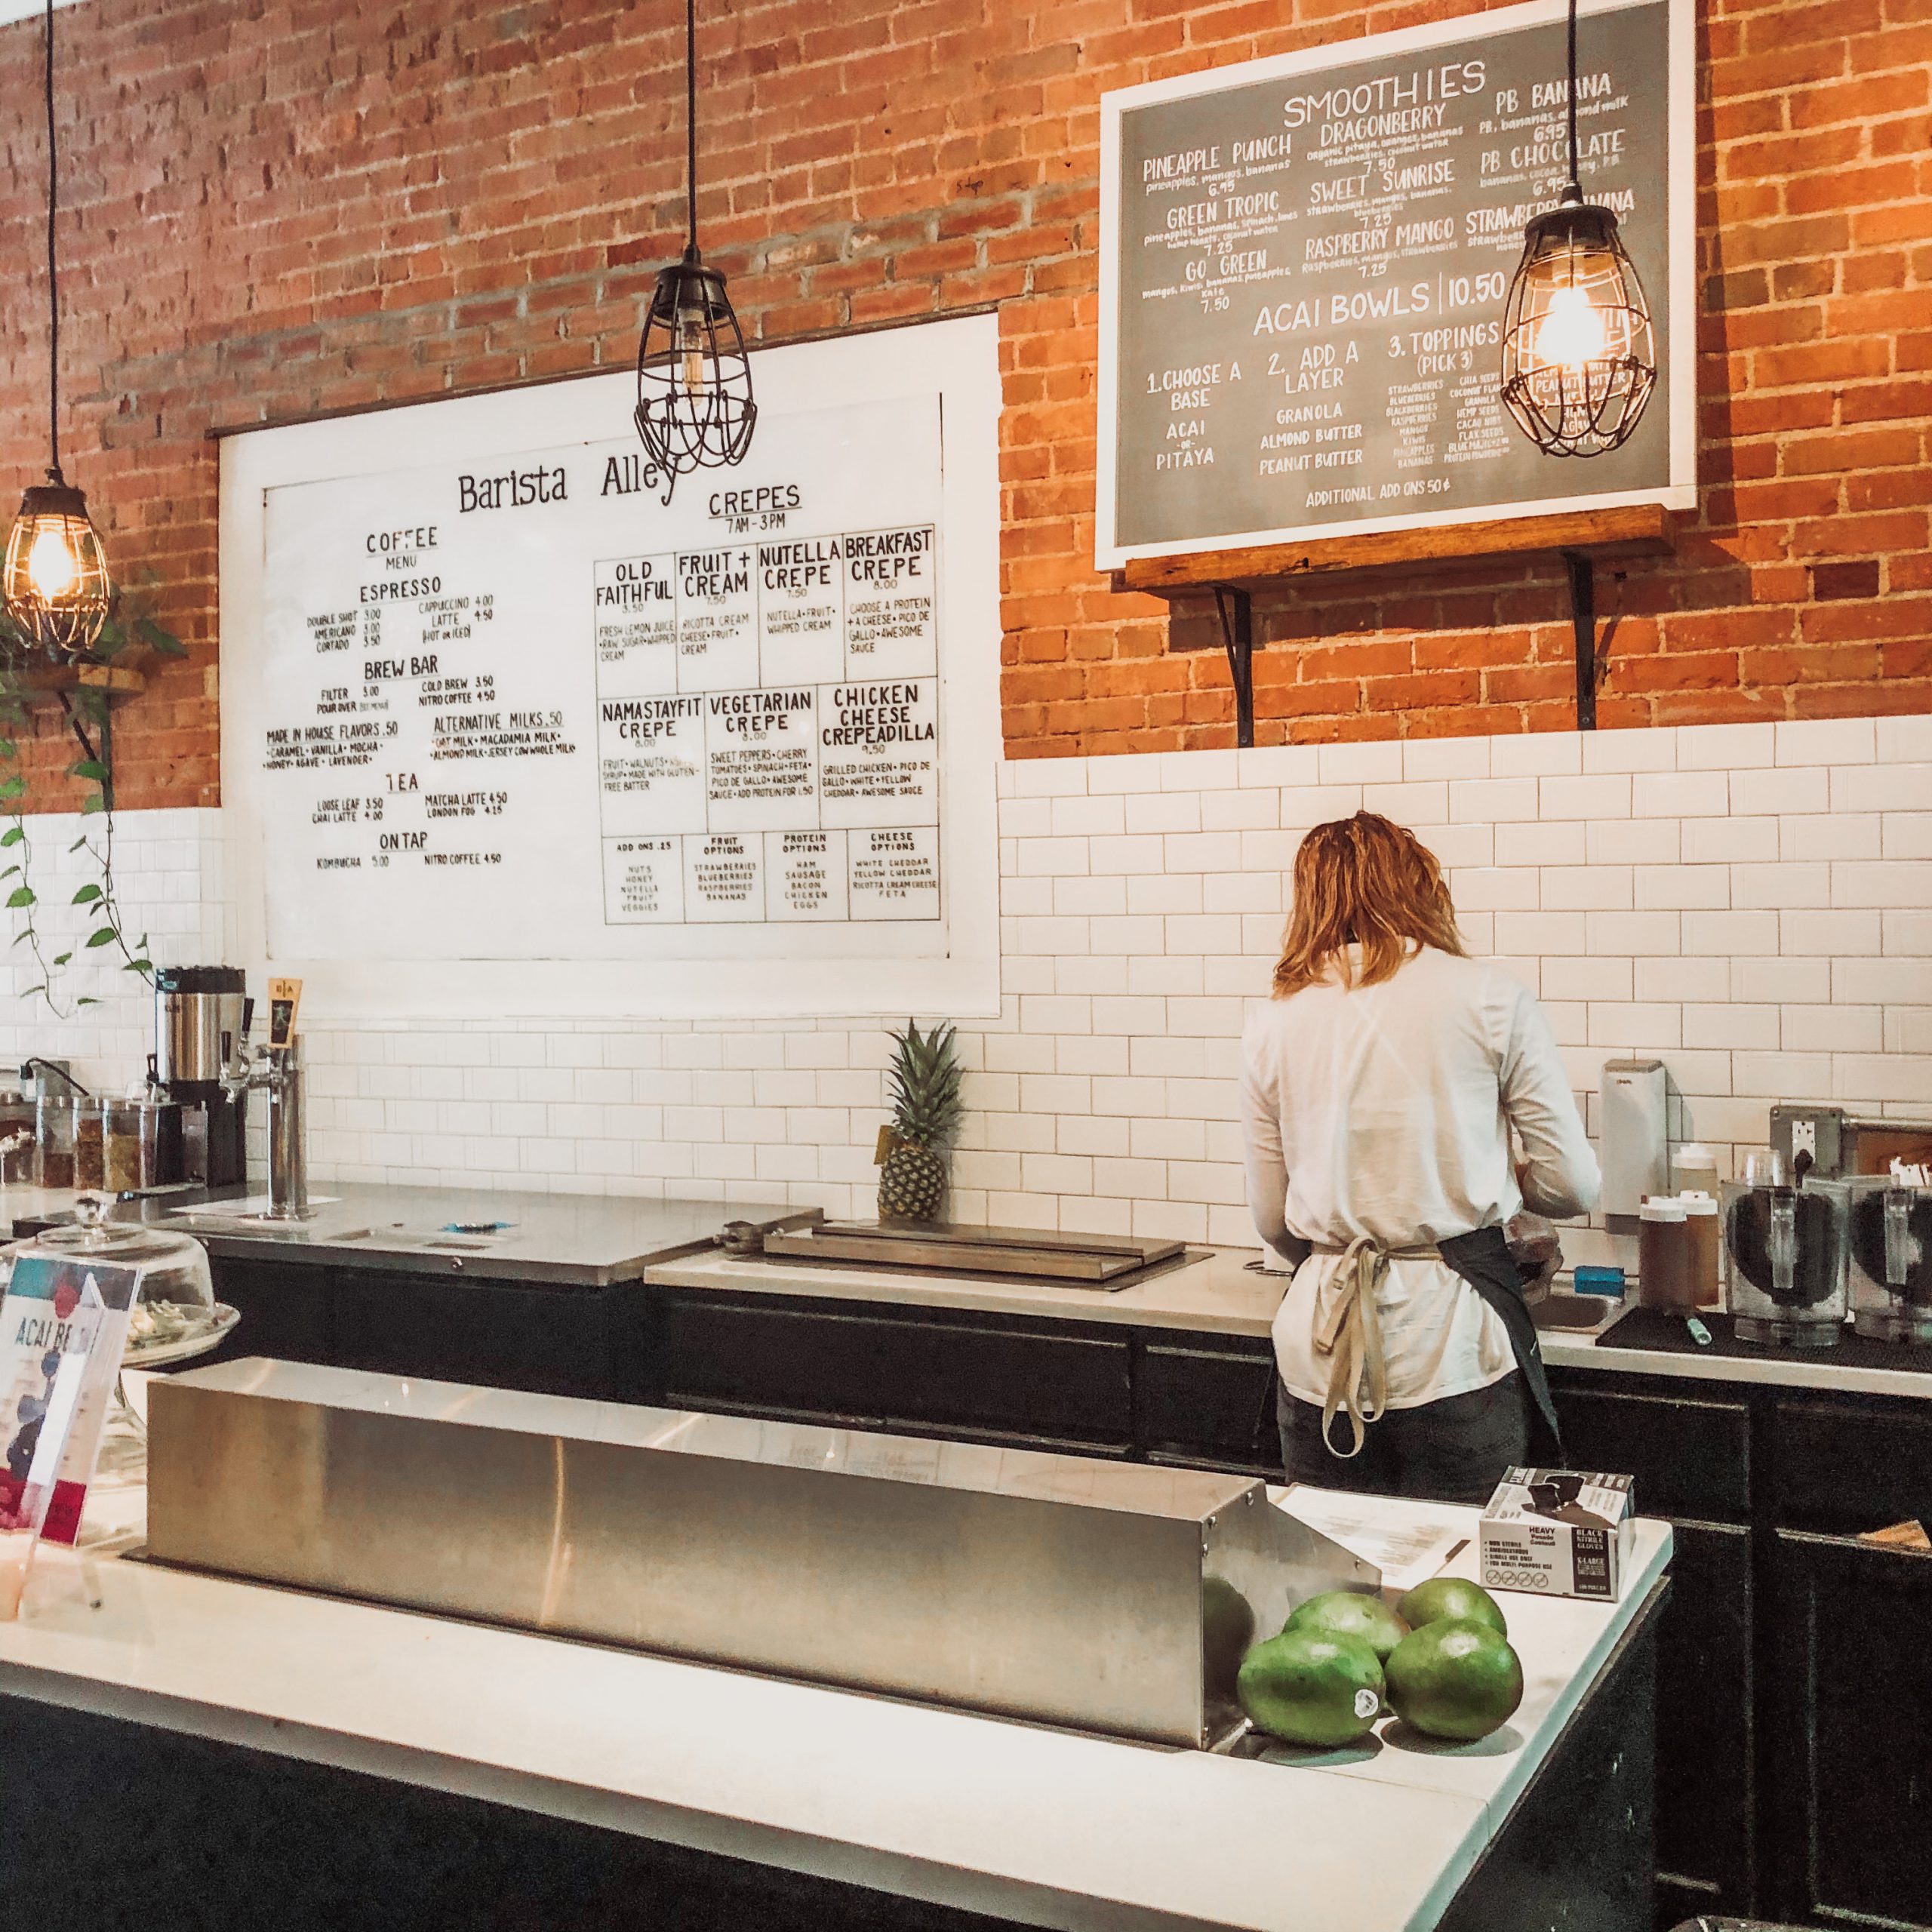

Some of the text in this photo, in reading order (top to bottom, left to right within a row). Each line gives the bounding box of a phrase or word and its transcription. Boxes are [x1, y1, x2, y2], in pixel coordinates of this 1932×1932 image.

[1284, 60, 1486, 128] SMOOTHIES
[1496, 90, 1518, 115] PB
[1321, 103, 1446, 147] DRAGONBERRY
[1143, 134, 1291, 181] PINEAPPLE PUNCH
[1481, 150, 1500, 174] PB
[1310, 158, 1455, 204] SWEET SUNRISE
[1167, 191, 1279, 229] GREEN TROPIC
[1306, 217, 1454, 260] RASPBERRY MANGO
[1186, 249, 1266, 281] GO GREEN
[1253, 272, 1505, 336] ACAI BOWLS 10.50
[1388, 321, 1500, 358] 3. TOPPINGS
[1268, 340, 1358, 375] 2. ADD A
[1229, 362, 1241, 381] A
[1285, 368, 1343, 394] LAYER
[1171, 388, 1211, 411] BASE
[1276, 402, 1343, 425] GRANOLA
[1166, 420, 1205, 440] ACAI
[1260, 423, 1362, 450] ALMOND BUTTER
[1155, 448, 1214, 470] PITAYA
[1260, 449, 1362, 475] PEANUT BUTTER
[458, 454, 681, 513] Barista Alley
[1305, 480, 1426, 508] ADDITIONAL ADD ONS
[709, 485, 800, 515] CREPES
[366, 527, 438, 552] COFFEE
[845, 530, 932, 558] BREAKFAST
[386, 555, 417, 570] MENU
[679, 552, 731, 575] FRUIT
[760, 540, 840, 567] NUTELLA
[616, 561, 651, 582] OLD
[764, 565, 830, 589] CREPE
[851, 556, 921, 581] CREPE
[360, 576, 441, 603] ESPRESSO
[596, 580, 673, 606] FAITHFUL
[685, 571, 748, 598] CREAM
[894, 597, 931, 609] PROTEIN
[432, 613, 459, 628] LATTE
[719, 614, 749, 626] CREAM
[851, 643, 875, 654] SAUCE
[365, 654, 438, 679] BREW BAR
[321, 688, 348, 701] FILTER
[422, 678, 468, 692] COLD BREW
[834, 685, 918, 706] CHICKEN
[419, 691, 472, 706] NITRO COFFEE
[603, 698, 701, 721] NAMASTAYFIT
[710, 691, 811, 715] VEGETARIAN
[434, 712, 501, 733] ALTERNATIVE
[726, 715, 788, 733] CREPE
[840, 706, 910, 726] CHEESE
[267, 722, 380, 744] MADE IN HOUSE FLAVORS
[620, 721, 676, 739] CREPE
[823, 723, 934, 746] CREPEADILLA
[386, 773, 419, 792] TEA
[317, 798, 360, 812] LOOSE LEAF
[425, 792, 486, 807] MATCHA LATTE
[334, 812, 356, 823] LATTE
[427, 808, 458, 819] LONDON
[380, 832, 428, 850] ON TAP
[711, 837, 737, 845] FRUIT
[784, 834, 826, 842] PROTEIN
[871, 832, 913, 841] CHEESE
[871, 843, 915, 851] OPTIONS
[424, 853, 480, 866] NITRO COFFEE
[704, 846, 744, 855] OPTIONS
[783, 844, 826, 853] OPTIONS
[317, 857, 361, 869] KOMBUCHA
[889, 858, 928, 867] CHEDDAR
[890, 869, 931, 877] CHEDDAR
[786, 870, 826, 880] SAUSAGE
[16, 1317, 52, 1348] ACAI
